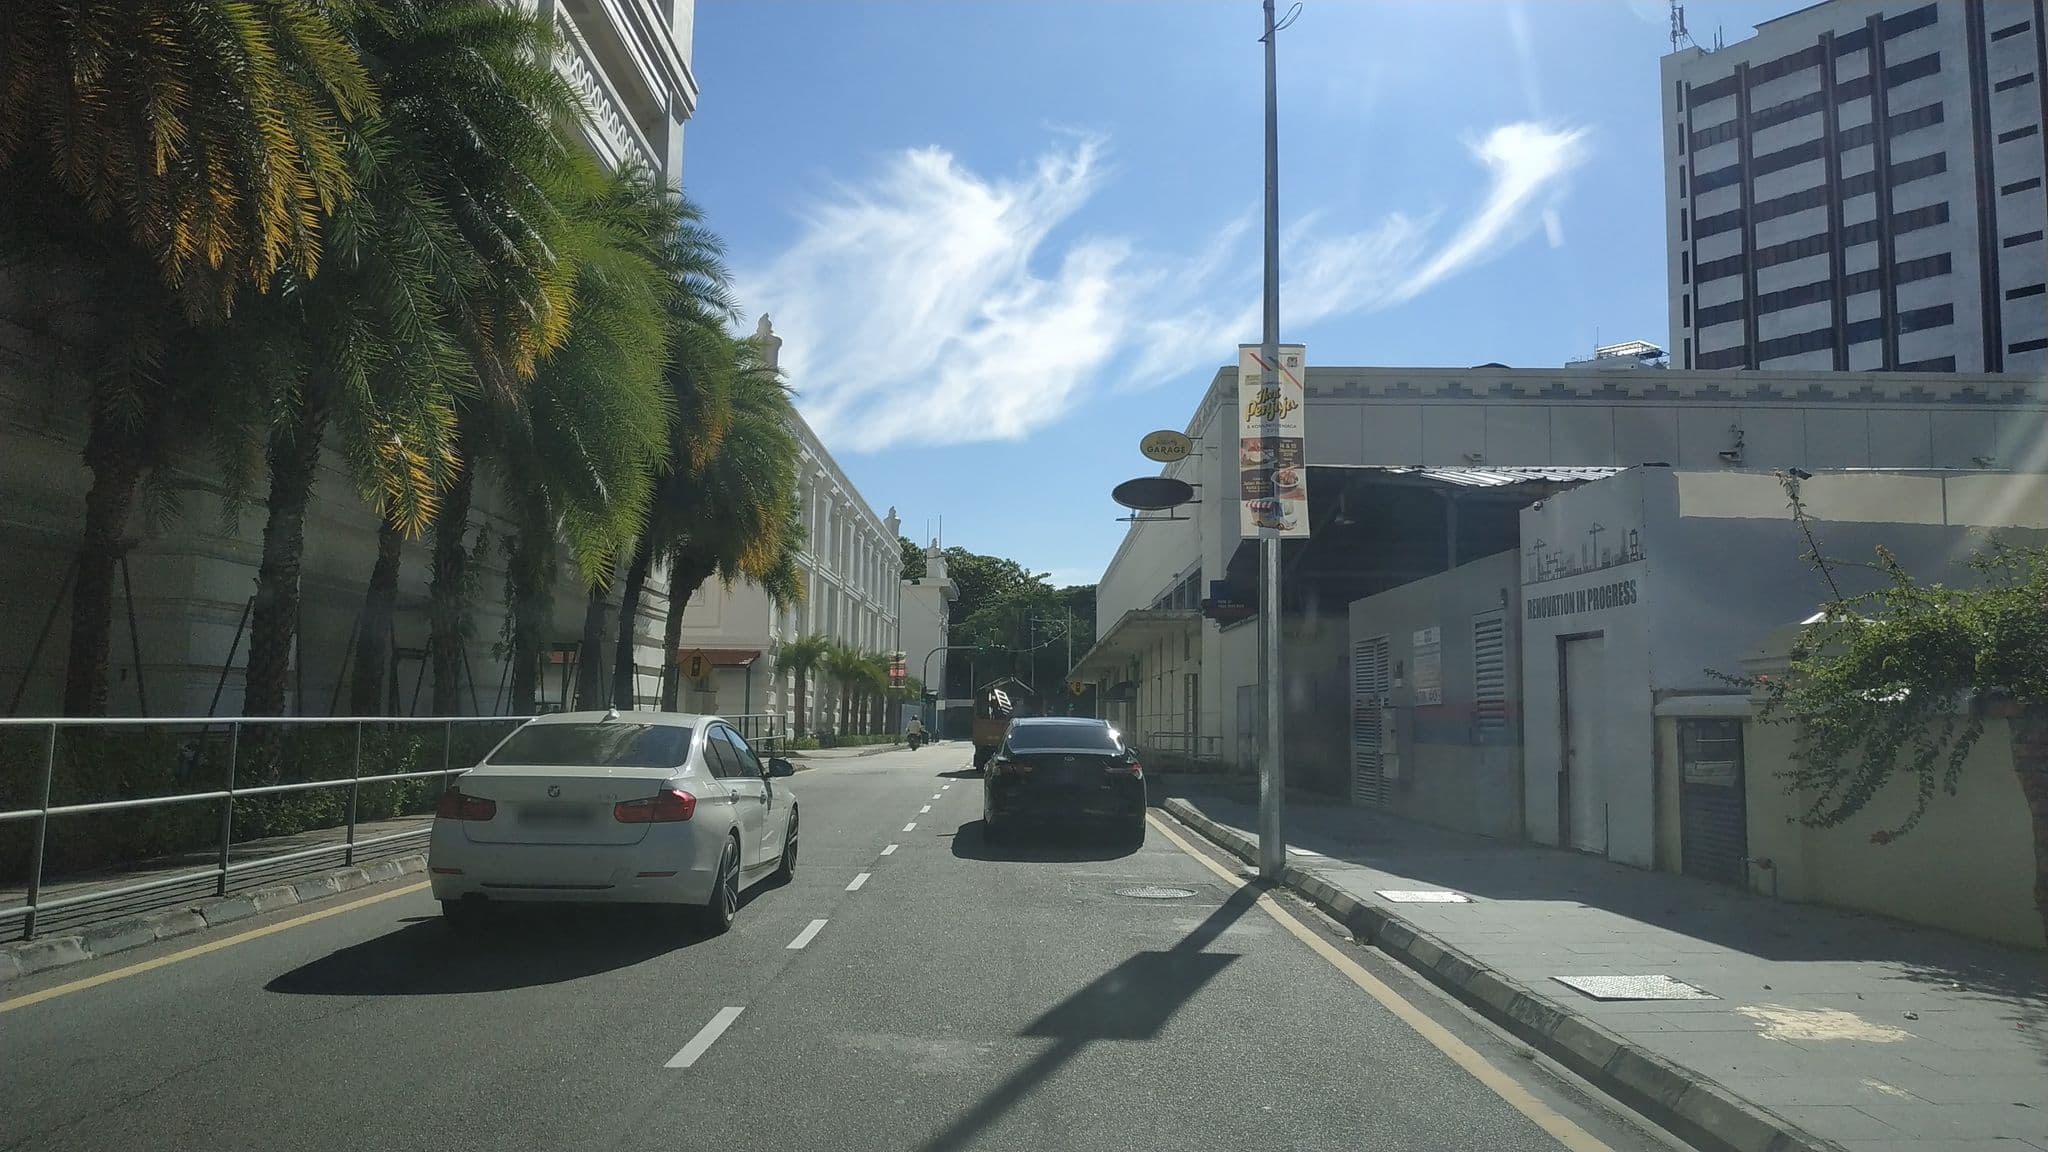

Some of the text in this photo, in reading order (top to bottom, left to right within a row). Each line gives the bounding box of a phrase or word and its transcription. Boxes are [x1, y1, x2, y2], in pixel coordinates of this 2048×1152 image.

[1146, 446, 1186, 455] GARAGE
[1527, 578, 1637, 620] RENOVATION IN PROGRESS
